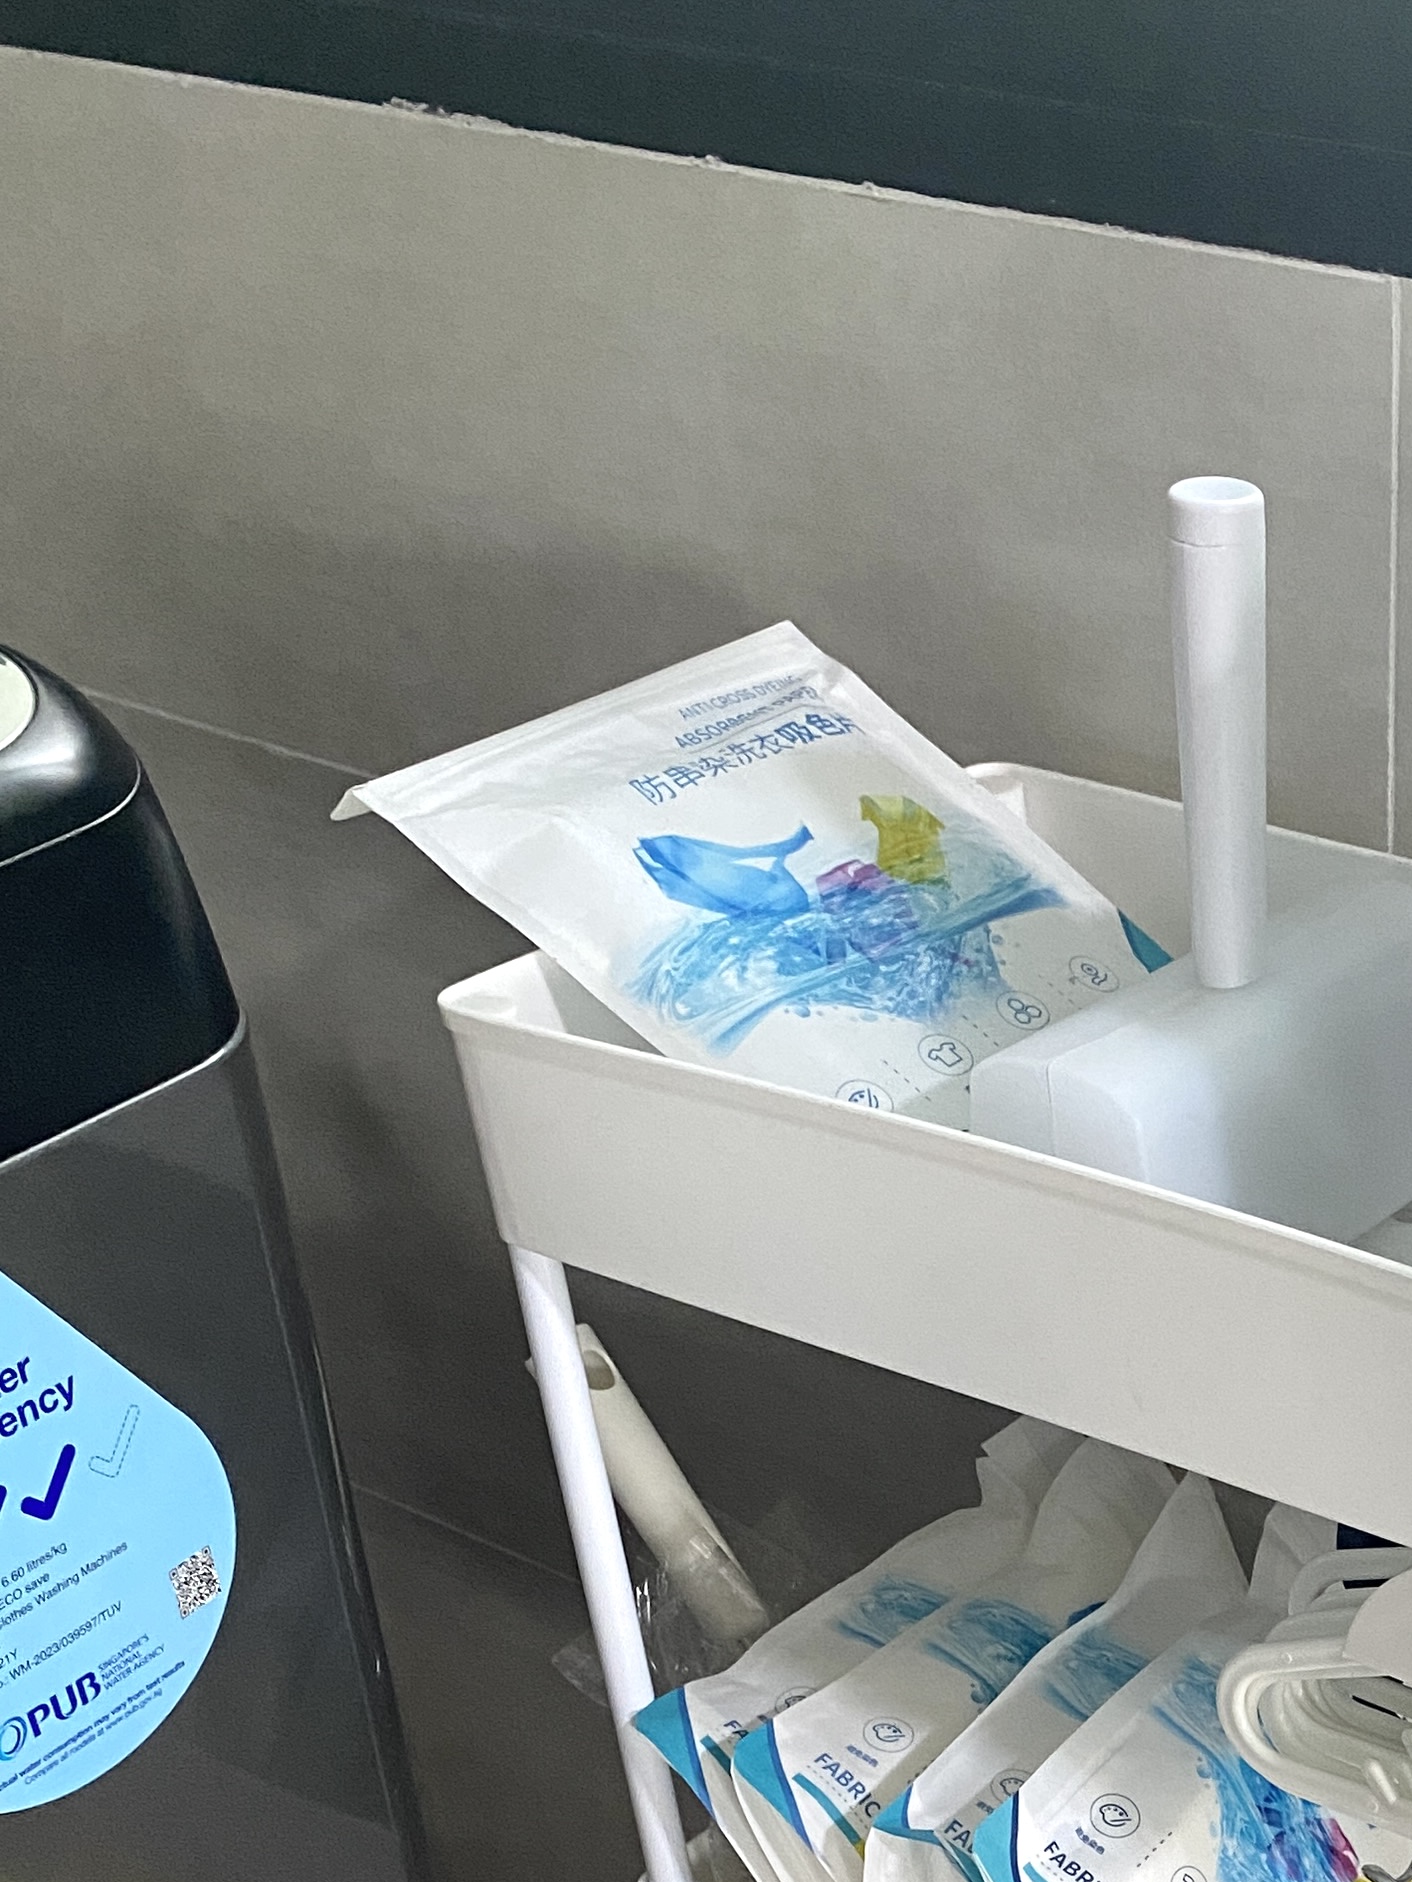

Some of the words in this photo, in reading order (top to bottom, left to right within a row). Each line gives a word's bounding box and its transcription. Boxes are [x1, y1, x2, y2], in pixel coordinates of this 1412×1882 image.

[628, 712, 866, 806] 防串染洗衣吸色片
[25, 1573, 50, 1594] save
[26, 1543, 67, 1573] litres/kg
[34, 1573, 80, 1606] Washing
[80, 1542, 128, 1577] Machines
[101, 1650, 142, 1681] NATIONAL
[104, 1666, 132, 1690] WATER
[133, 1643, 164, 1671] AGENCY
[27, 1672, 101, 1738] PUB
[814, 1753, 881, 1818] FABRIC
